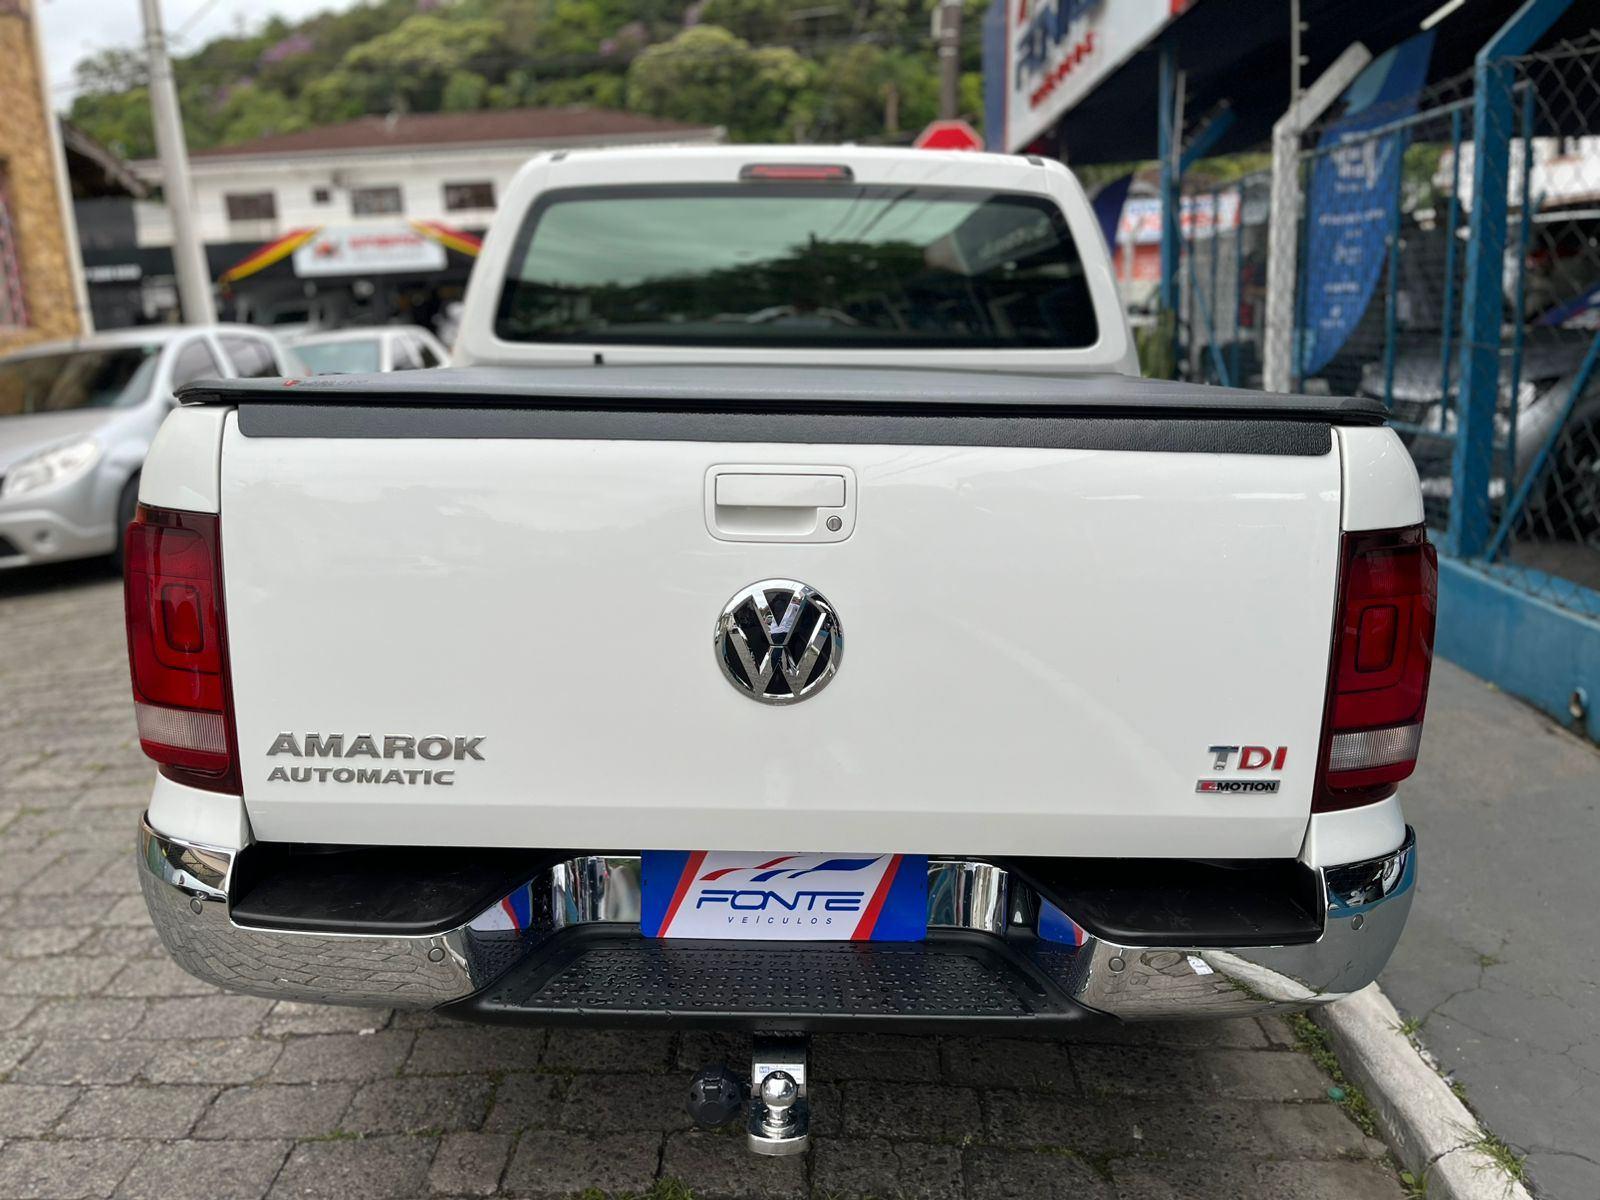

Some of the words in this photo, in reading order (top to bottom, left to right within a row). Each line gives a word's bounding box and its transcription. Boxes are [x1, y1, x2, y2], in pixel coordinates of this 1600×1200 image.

[266, 731, 486, 761] AMAROK
[1208, 745, 1288, 771] TDI
[267, 766, 455, 786] AUTOMATIC
[696, 889, 865, 911] FONTE
[727, 915, 833, 925] VEÍCULOS
